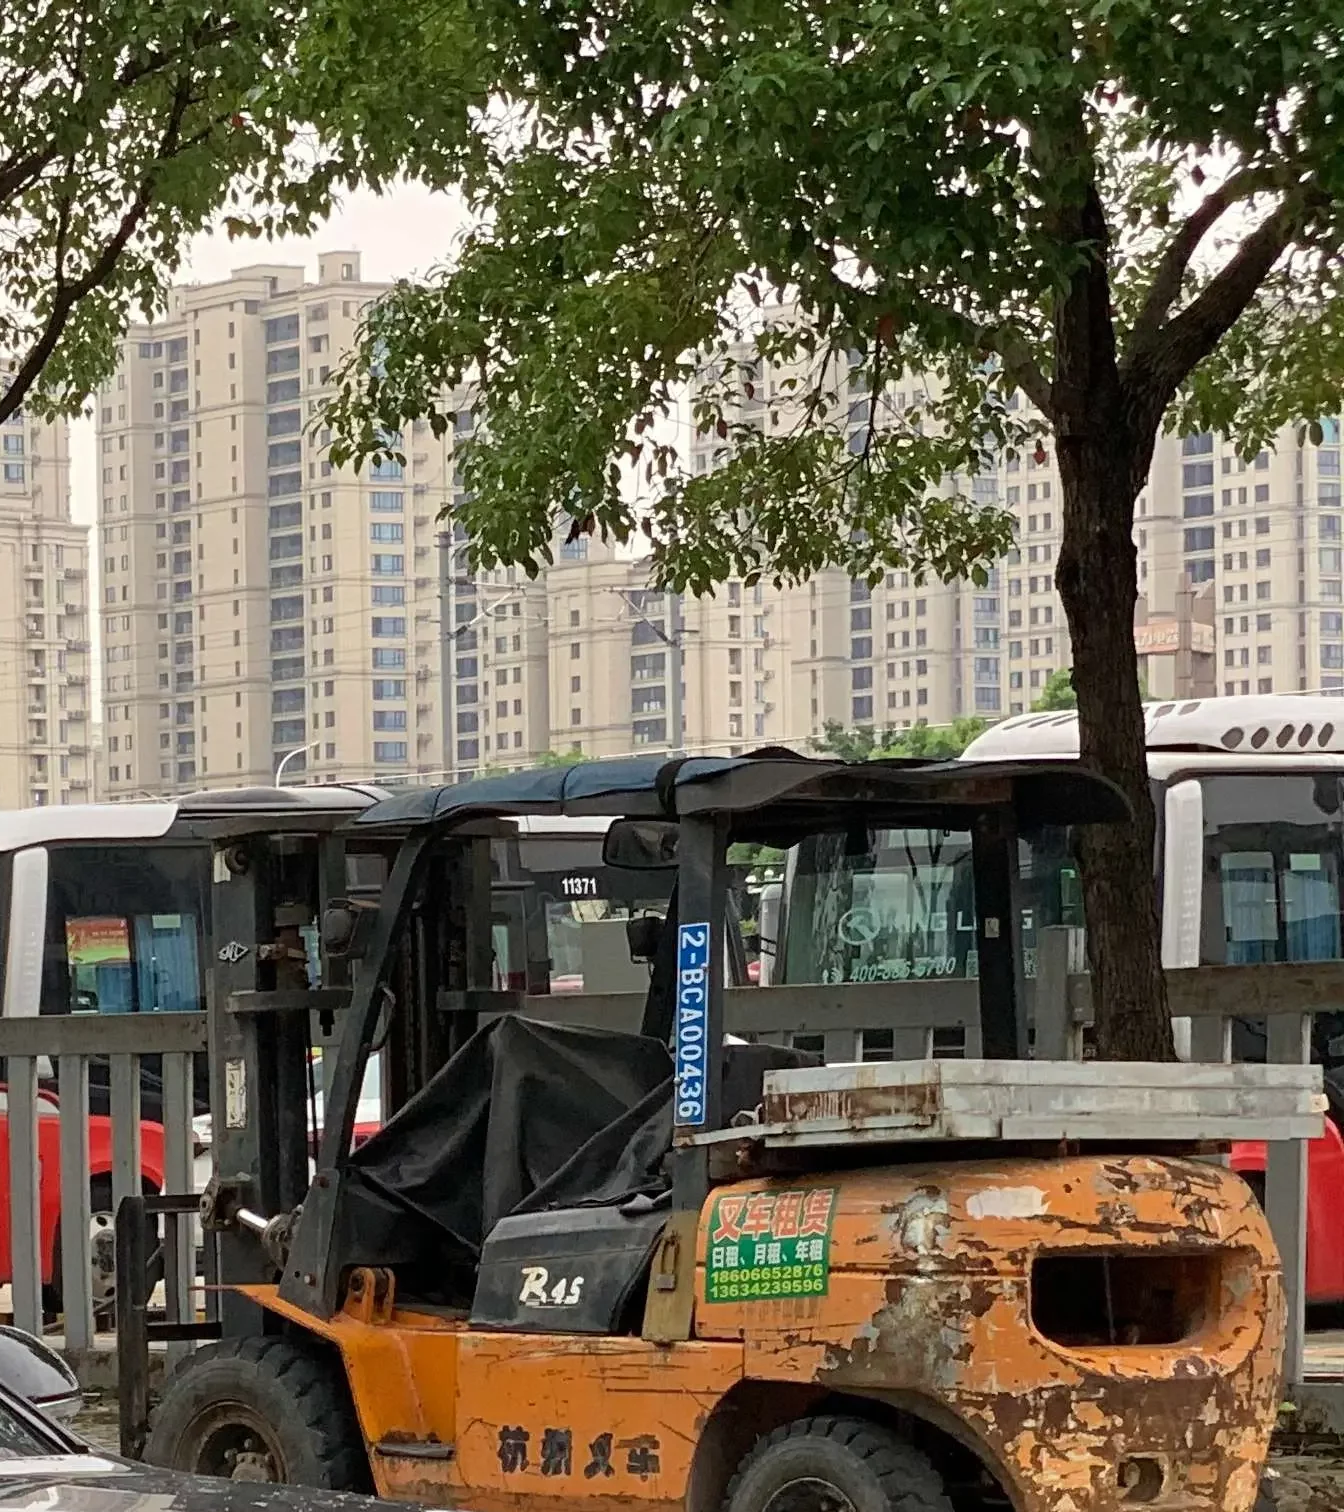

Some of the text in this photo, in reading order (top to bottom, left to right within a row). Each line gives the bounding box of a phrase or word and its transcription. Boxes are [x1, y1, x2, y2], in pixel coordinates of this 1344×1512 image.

[562, 877, 597, 895] 11371
[677, 930, 706, 1119] 2-BCA00436
[712, 1188, 834, 1244] 叉车租赁
[710, 1264, 824, 1284] 18606652876
[710, 1279, 824, 1298] 13634239596
